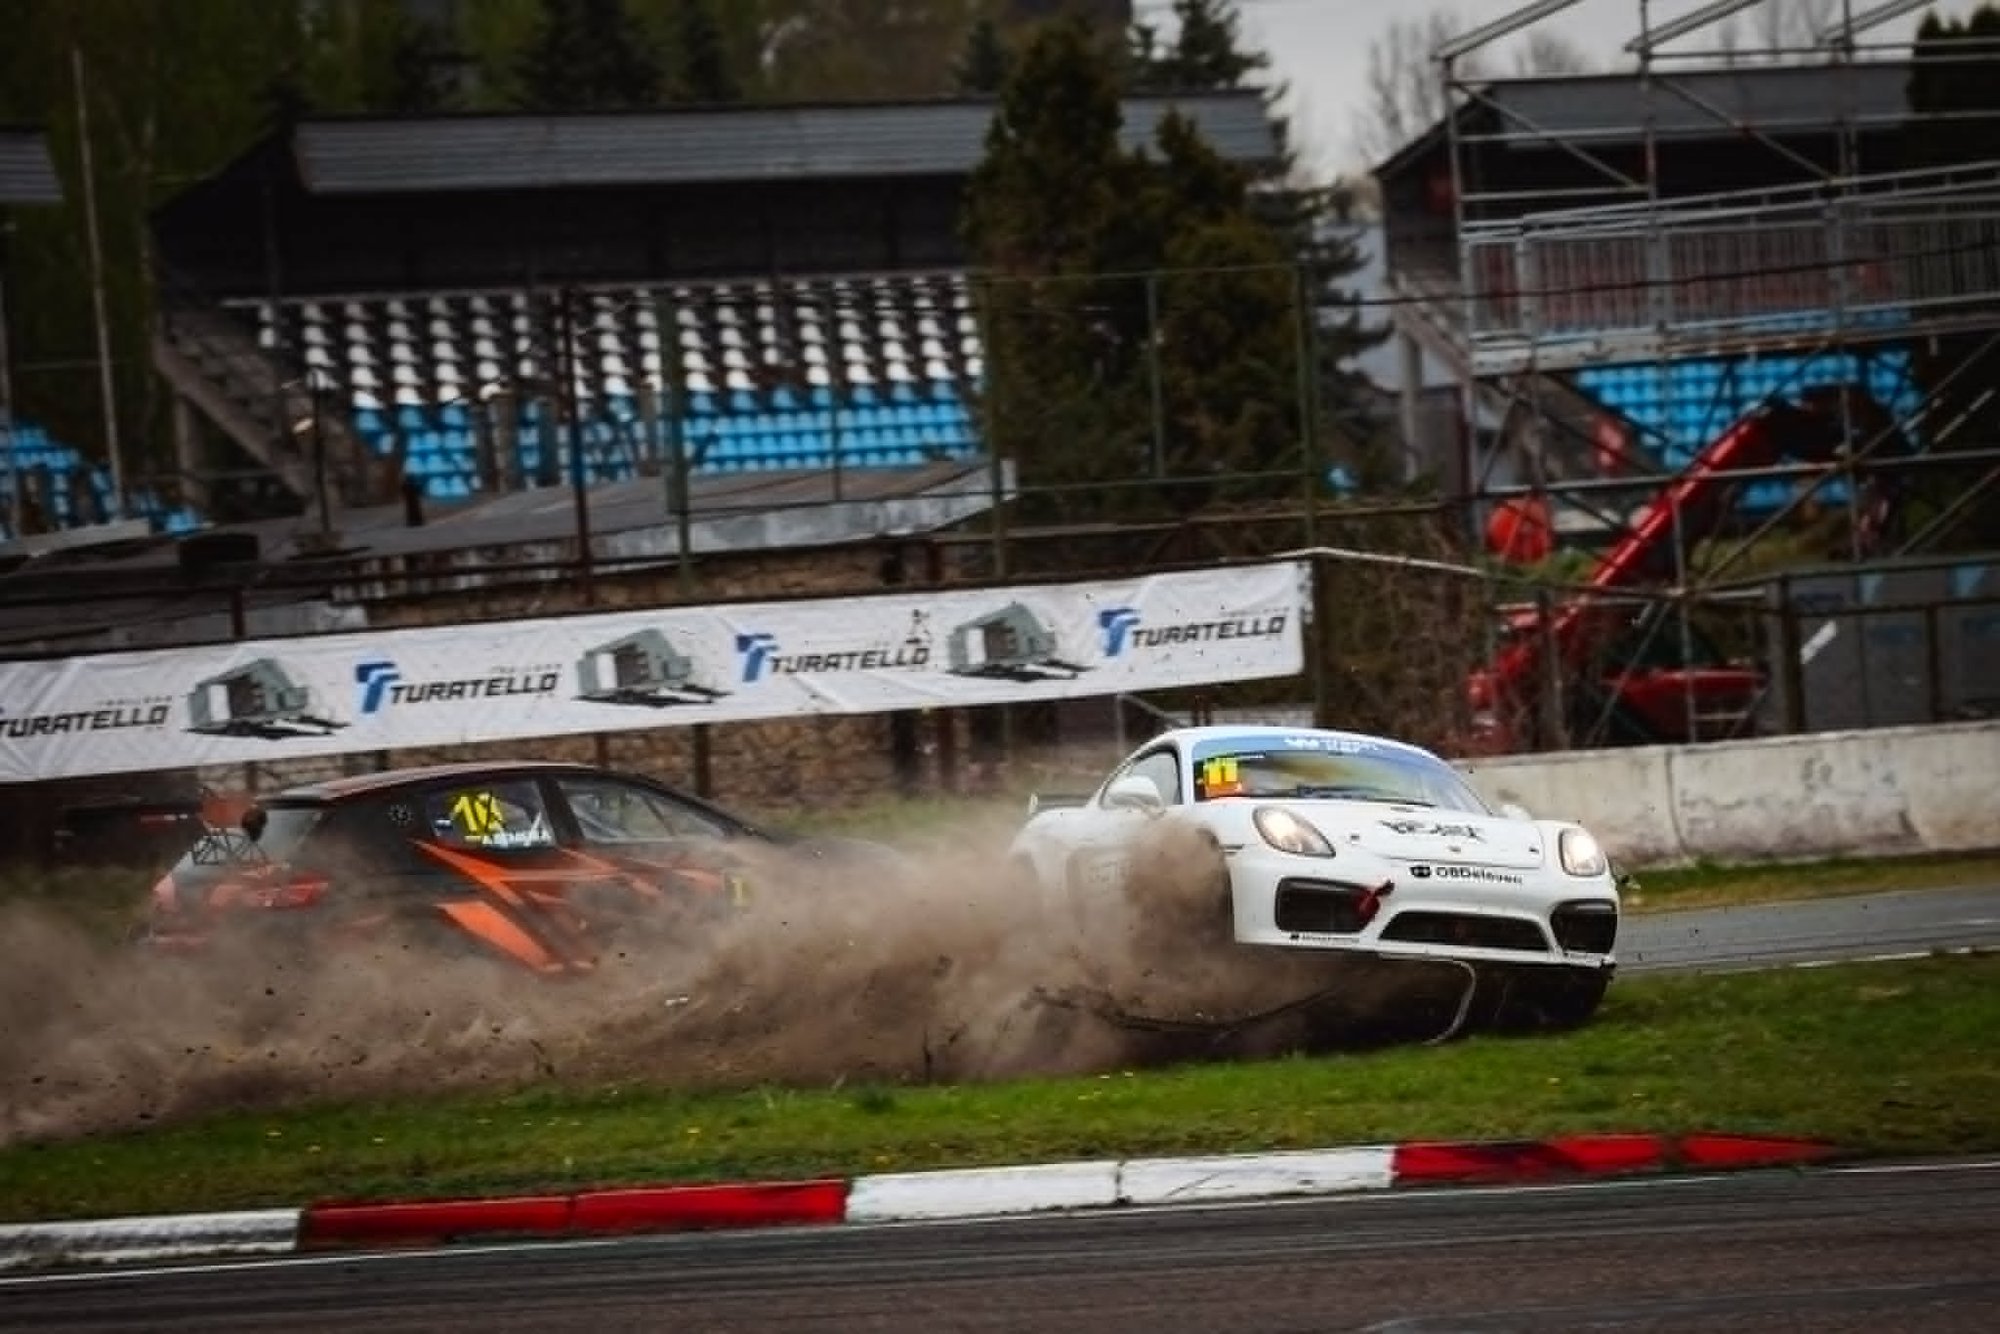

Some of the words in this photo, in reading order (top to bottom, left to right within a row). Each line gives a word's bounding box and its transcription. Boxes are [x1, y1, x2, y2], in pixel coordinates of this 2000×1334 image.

[1132, 616, 1285, 648] TURATELLO
[768, 647, 930, 674] TURATELLO
[390, 672, 559, 703] TURATELLO
